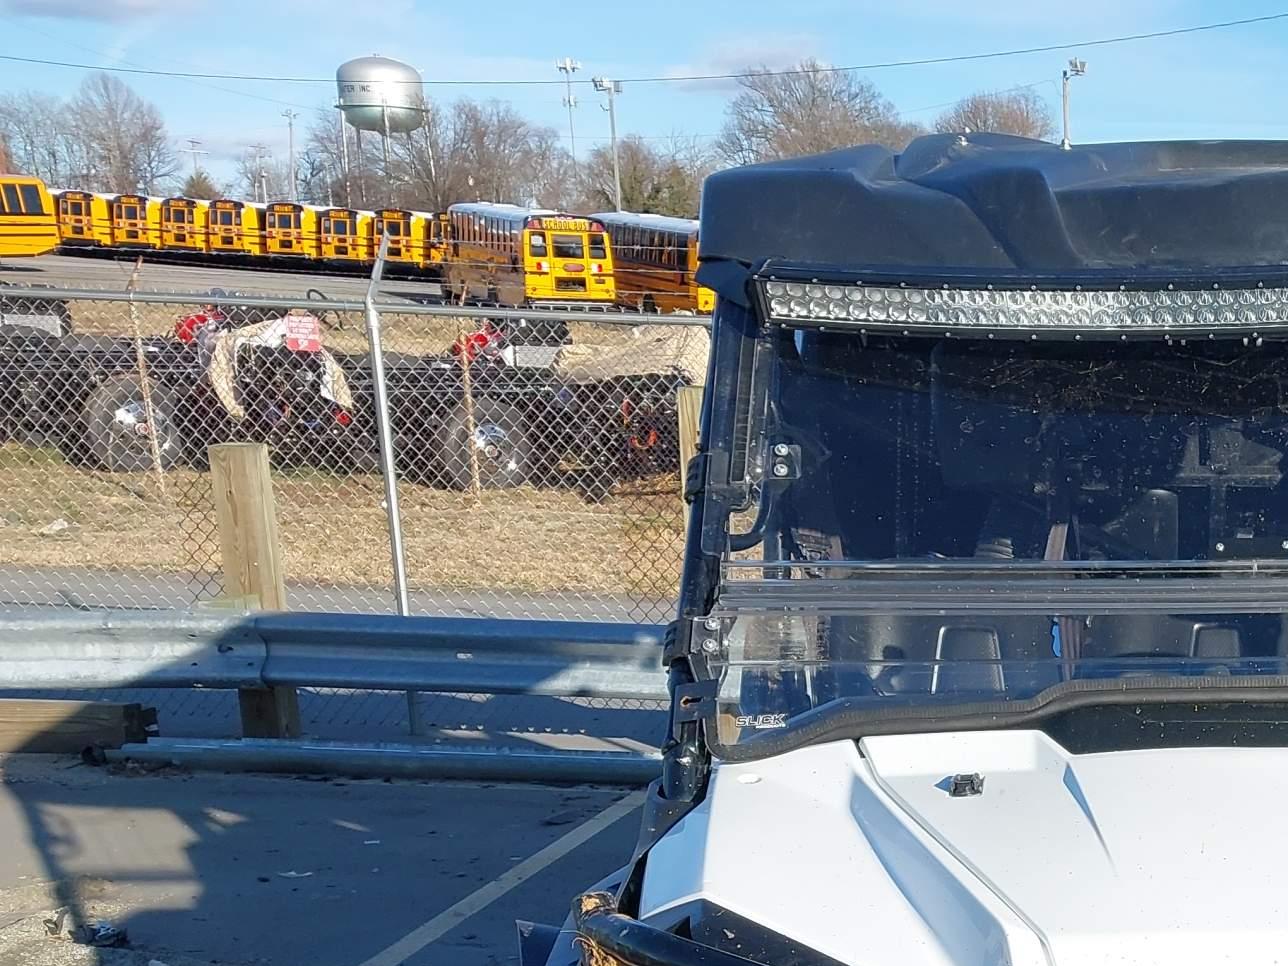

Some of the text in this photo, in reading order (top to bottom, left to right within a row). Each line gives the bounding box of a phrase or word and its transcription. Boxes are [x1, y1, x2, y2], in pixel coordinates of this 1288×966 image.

[544, 220, 587, 231] SCHOOL BUS
[736, 713, 786, 727] SLICK
